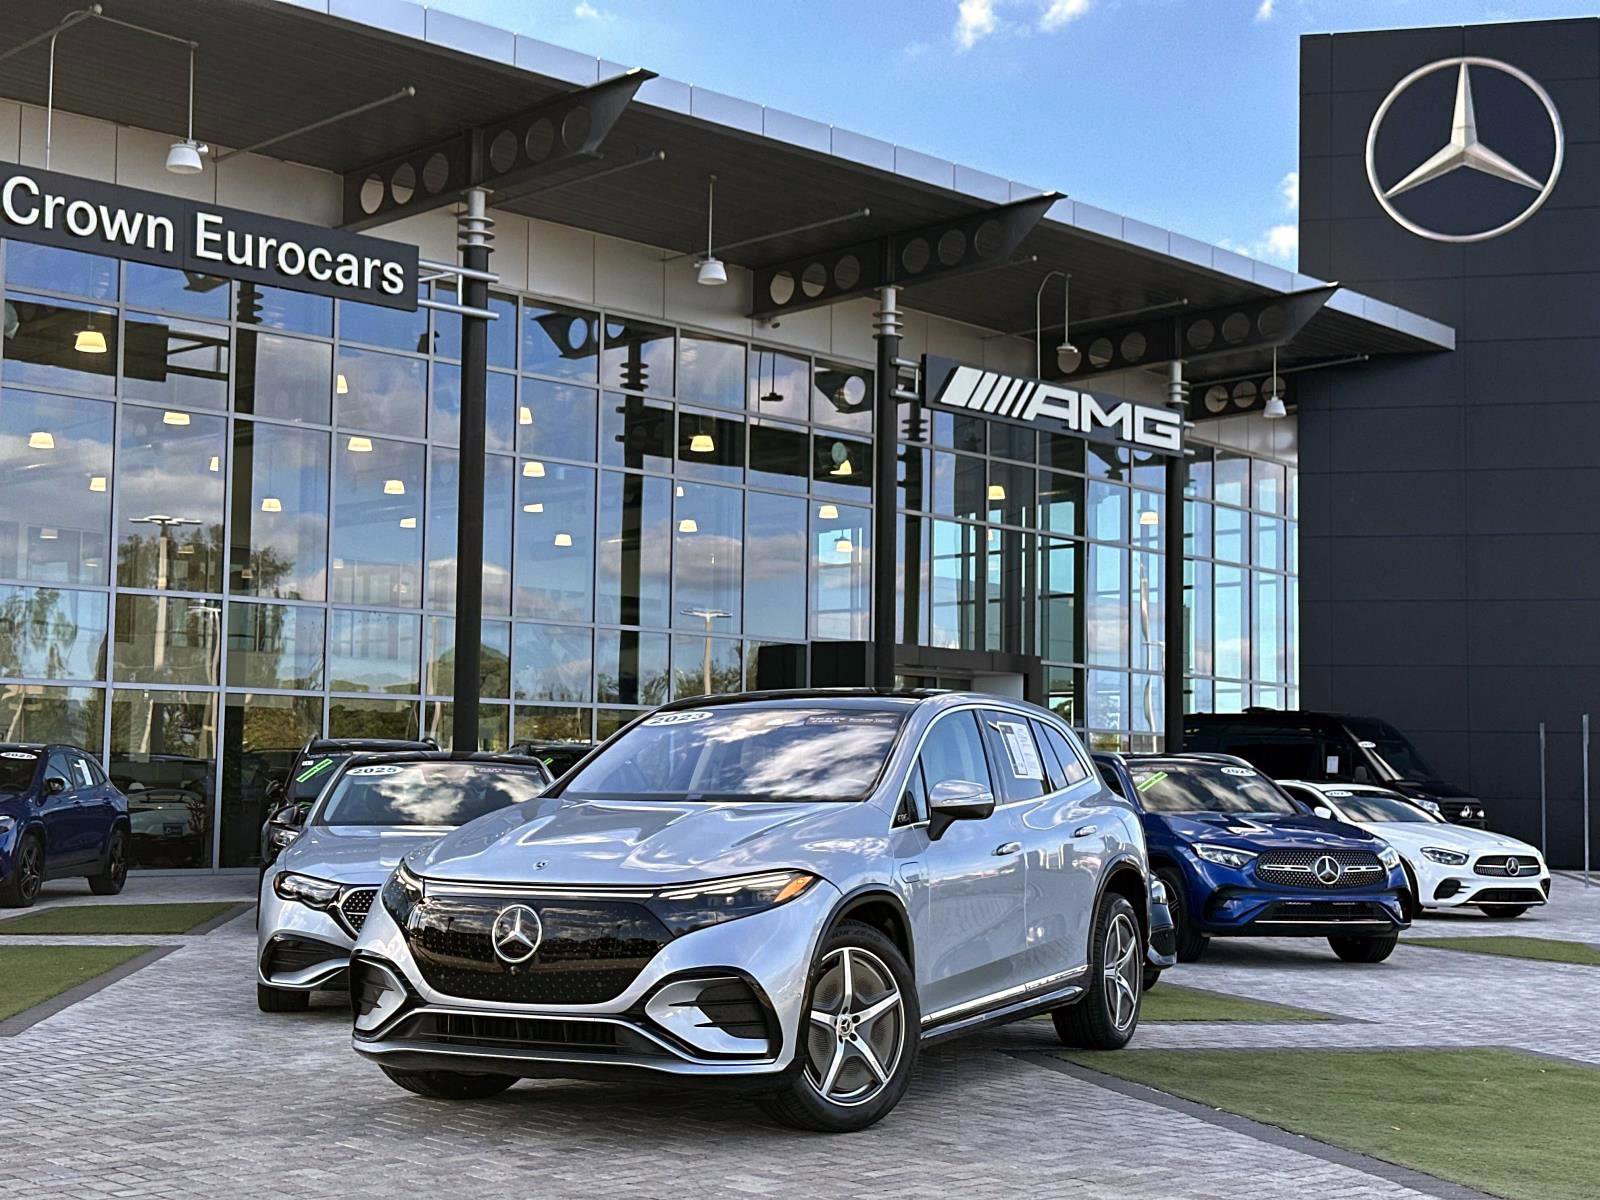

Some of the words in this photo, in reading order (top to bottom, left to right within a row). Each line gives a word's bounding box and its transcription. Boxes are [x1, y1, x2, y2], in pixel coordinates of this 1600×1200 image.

[2, 175, 174, 252] Crown
[195, 212, 404, 295] Eurocars
[648, 712, 706, 725] 2023
[353, 767, 397, 775] 2025
